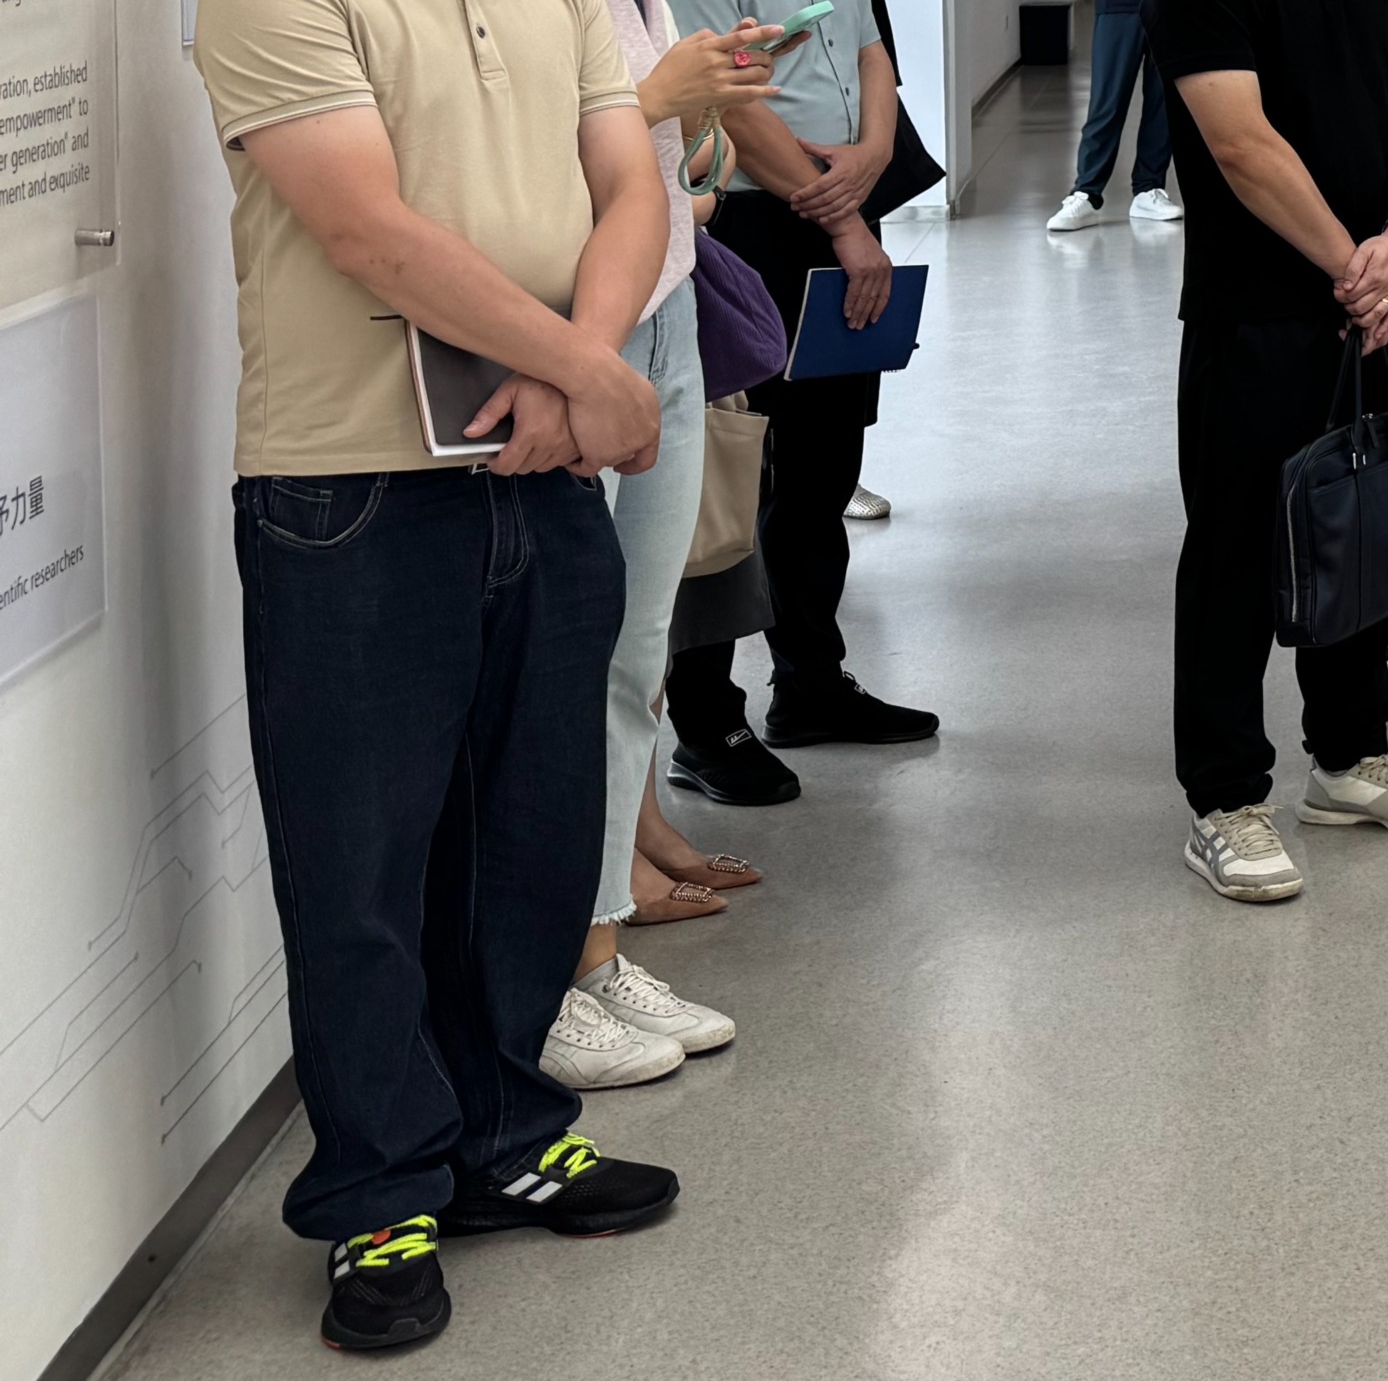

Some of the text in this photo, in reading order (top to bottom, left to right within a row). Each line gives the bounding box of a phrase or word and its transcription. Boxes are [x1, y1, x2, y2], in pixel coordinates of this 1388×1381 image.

[33, 60, 88, 93] established
[78, 97, 89, 116] to
[71, 126, 89, 151] and
[28, 172, 47, 198] and
[49, 162, 90, 194] exquisite
[30, 544, 84, 591] researchers
